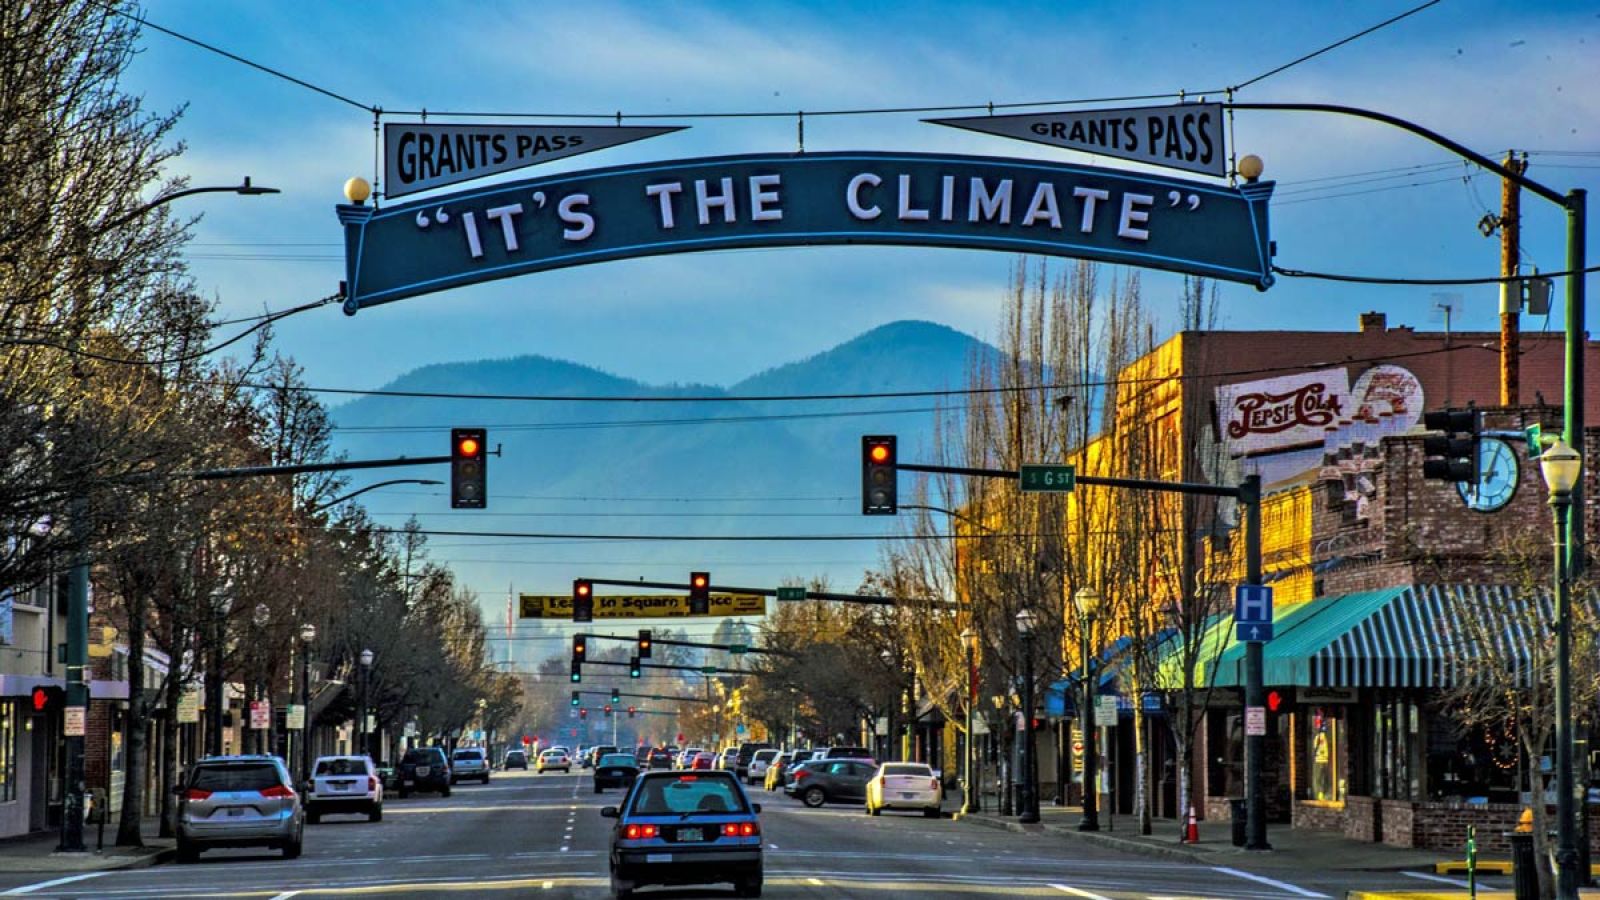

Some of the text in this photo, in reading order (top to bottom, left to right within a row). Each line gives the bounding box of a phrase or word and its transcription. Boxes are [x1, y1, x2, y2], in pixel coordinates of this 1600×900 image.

[398, 131, 586, 184] GRANTS PASS
[1030, 111, 1214, 165] GRANTS PASS
[646, 174, 784, 229] THE
[1044, 471, 1053, 485] G
[1057, 472, 1070, 485] ST
[1241, 588, 1268, 621] H
